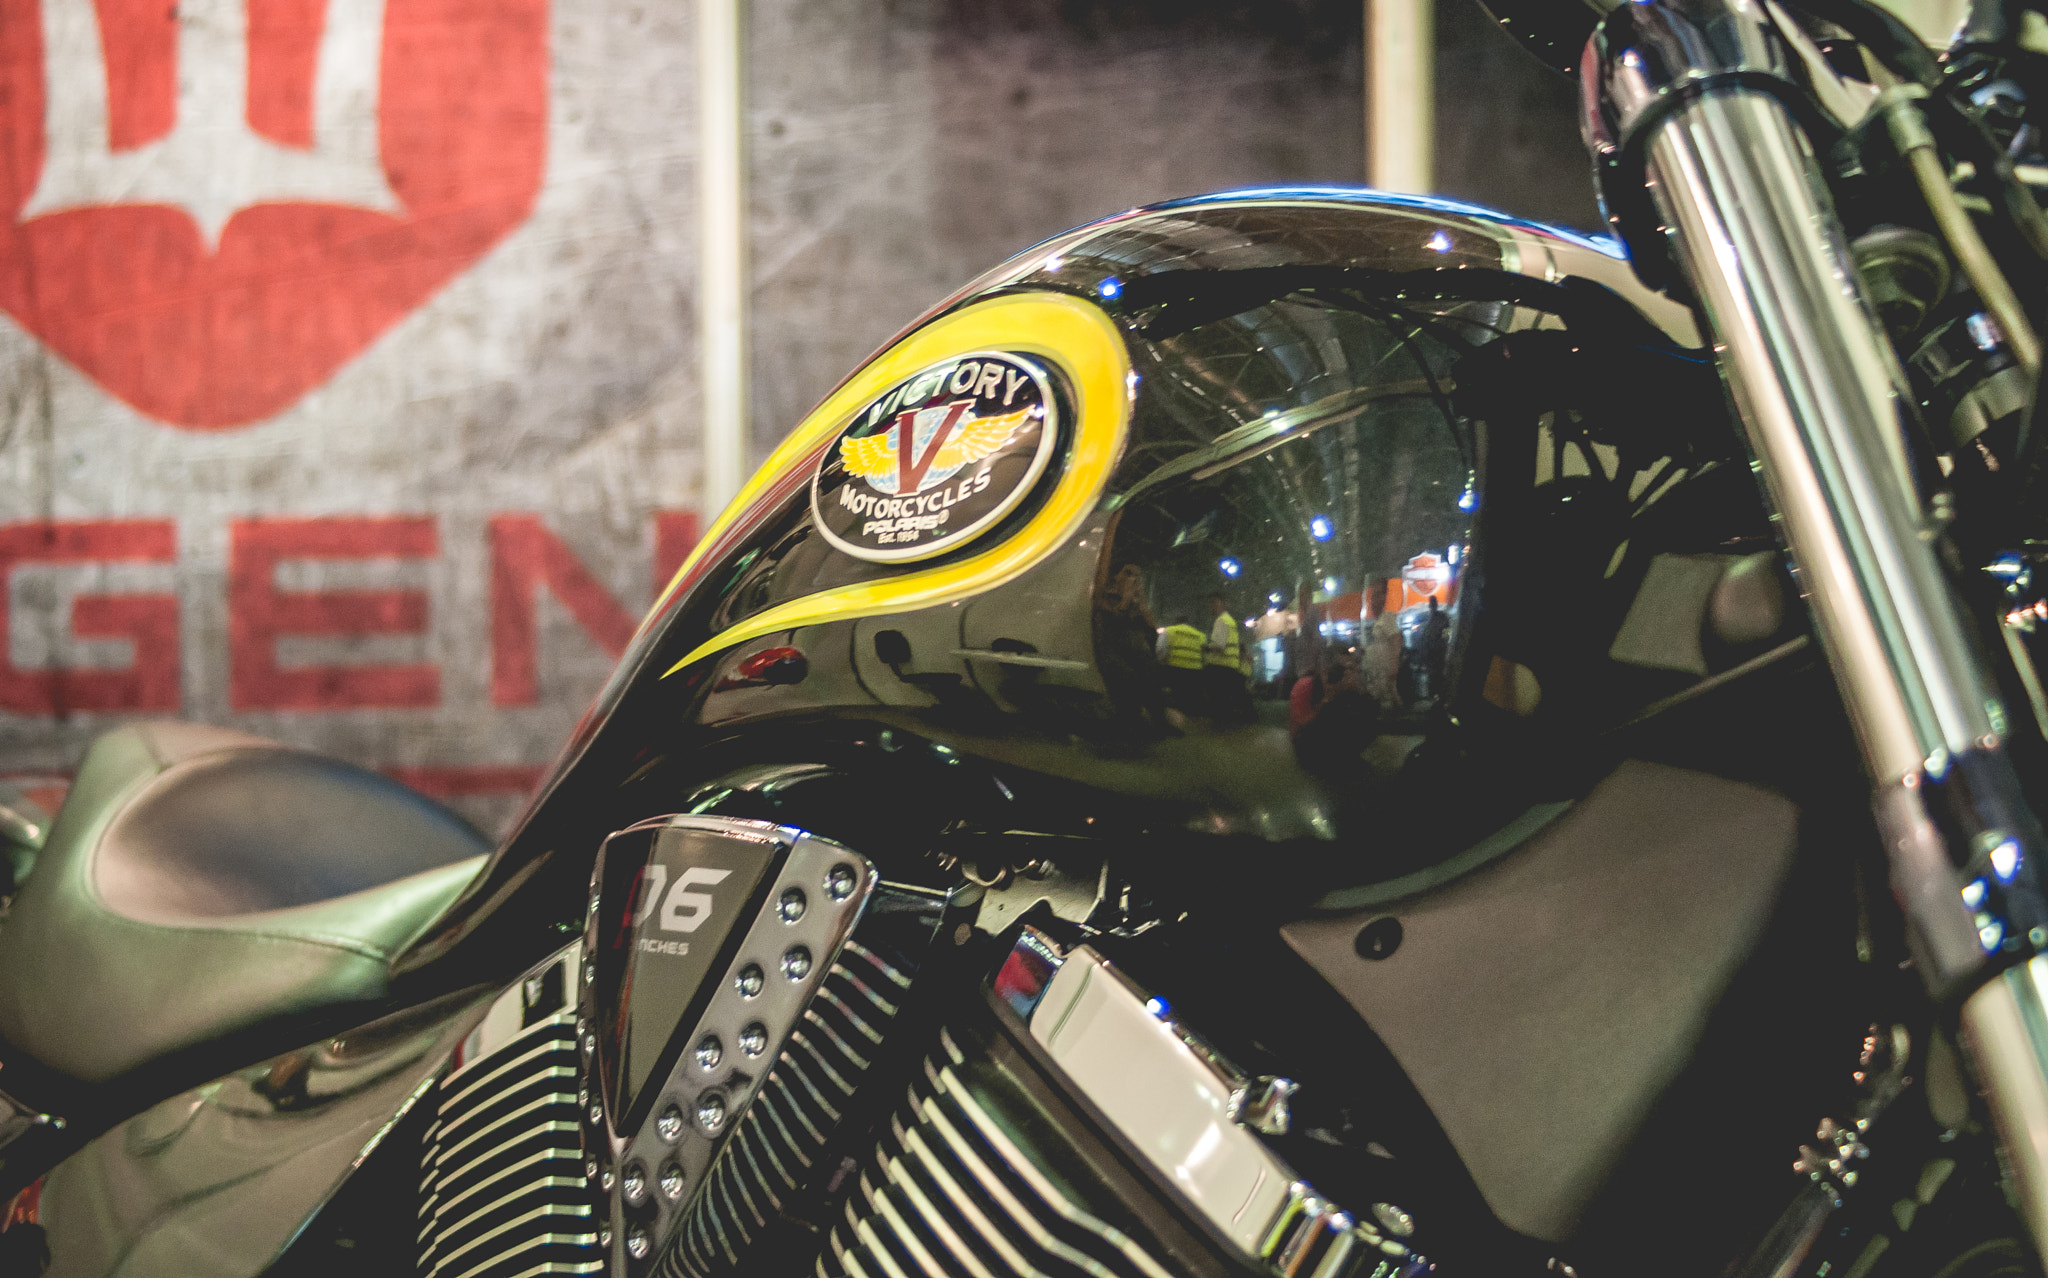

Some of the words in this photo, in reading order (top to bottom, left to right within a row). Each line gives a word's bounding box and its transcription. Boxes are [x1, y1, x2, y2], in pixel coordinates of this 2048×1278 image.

[868, 362, 1028, 427] VICTORY
[893, 398, 976, 498] V
[840, 468, 991, 519] MOTORCYCLES
[638, 938, 689, 955] NCHES
